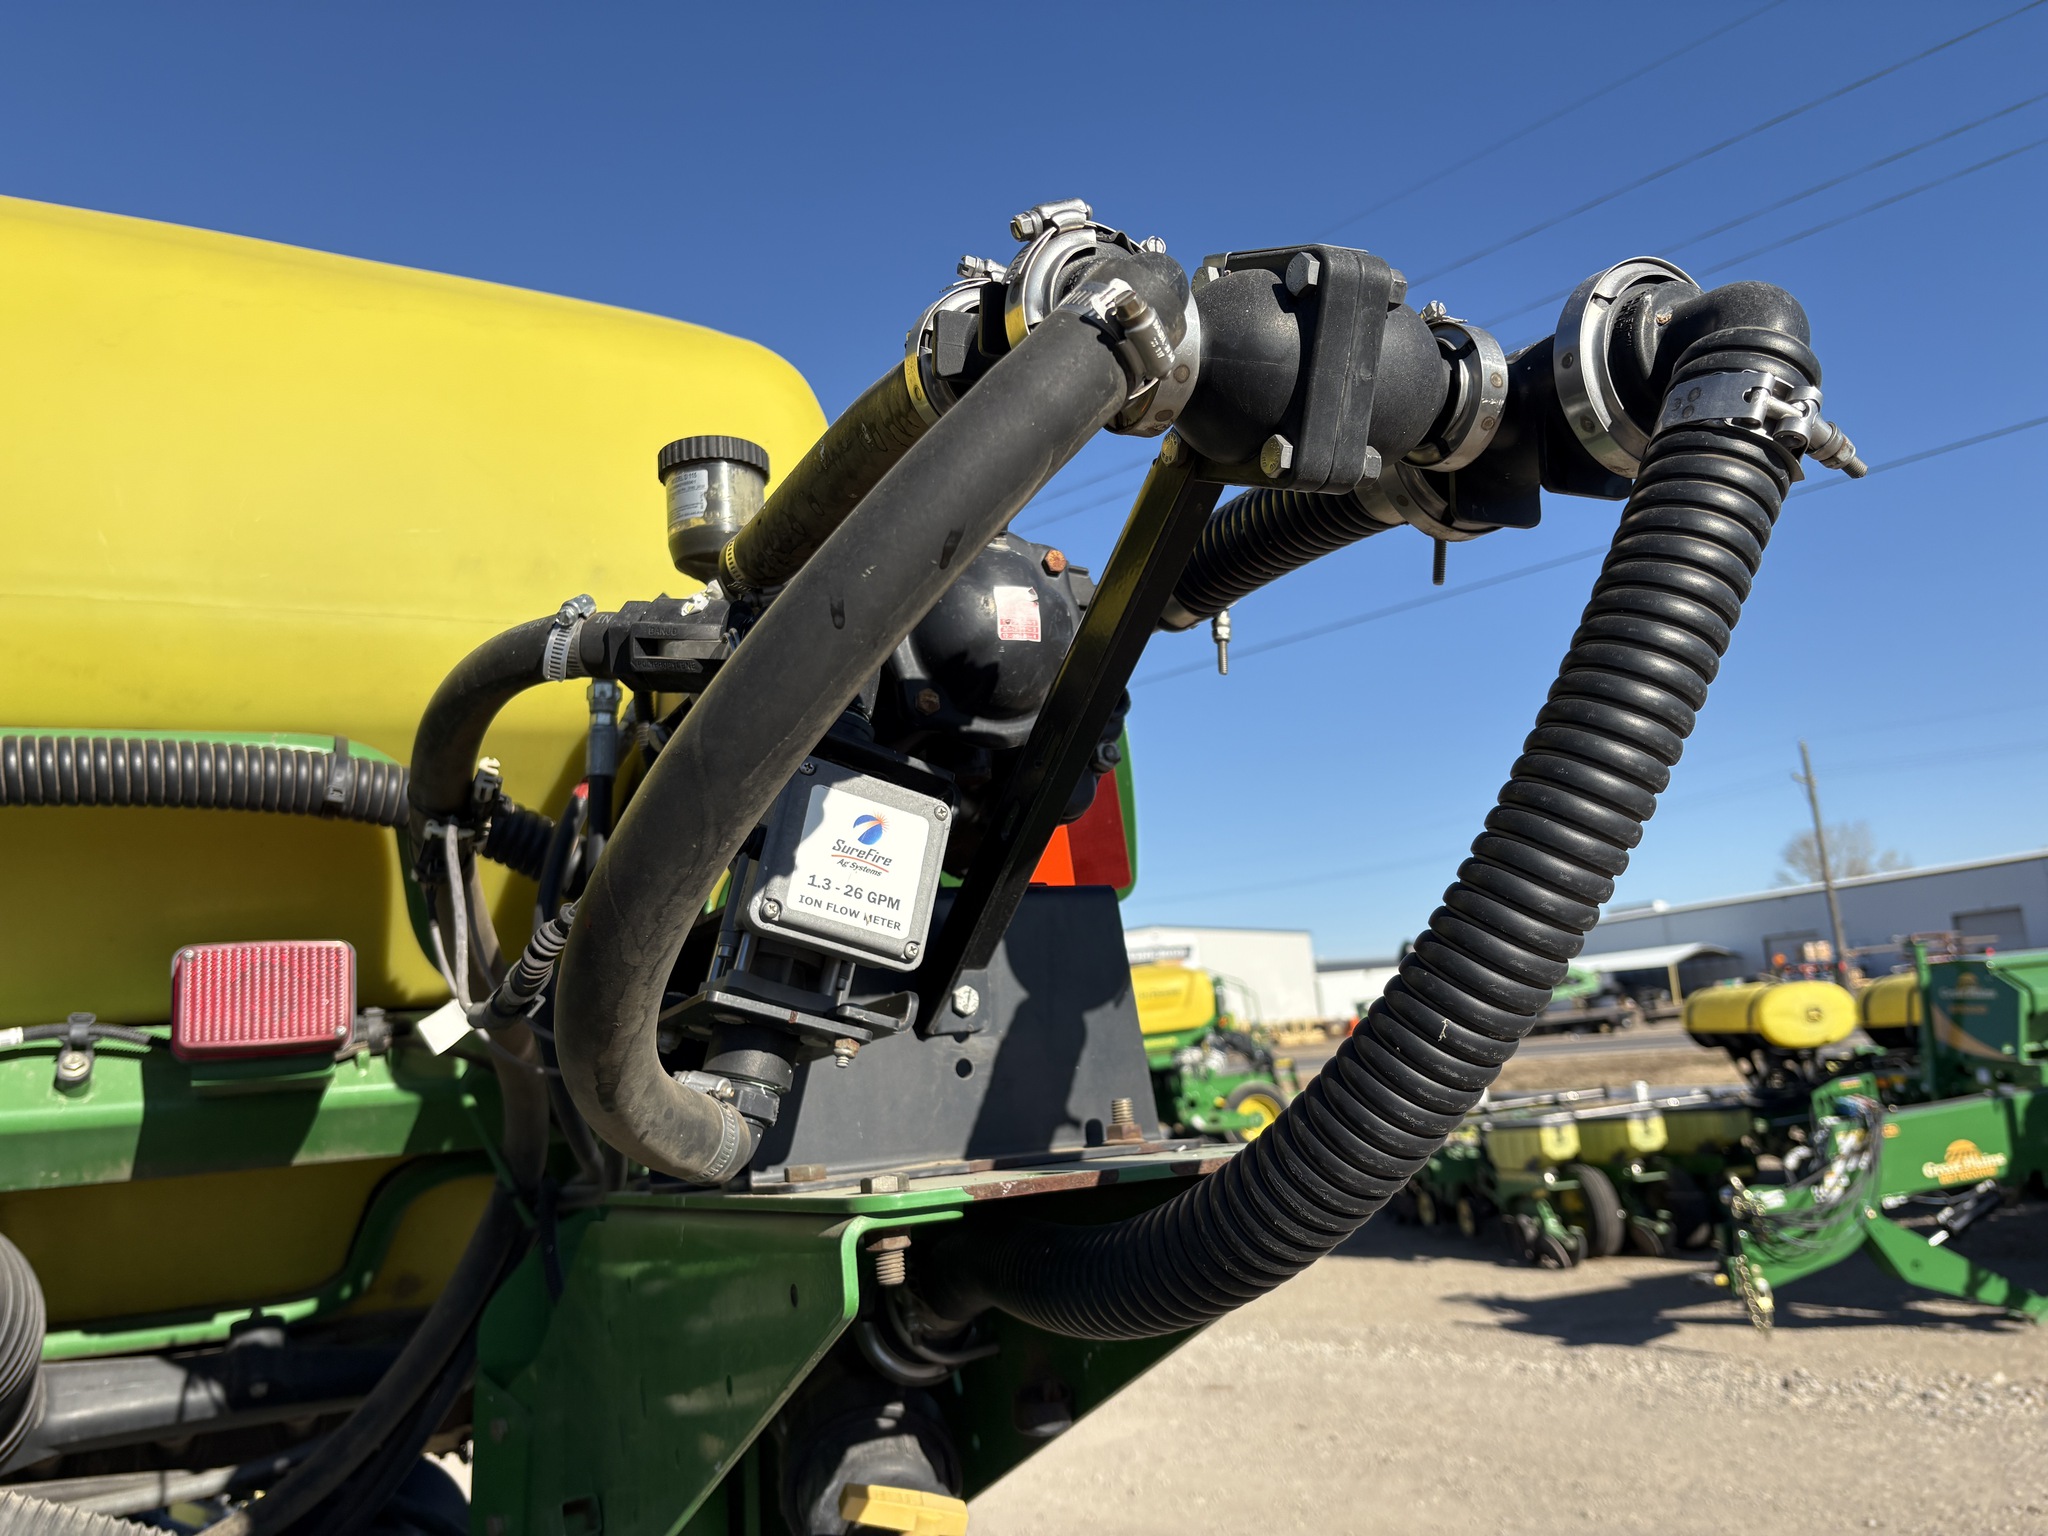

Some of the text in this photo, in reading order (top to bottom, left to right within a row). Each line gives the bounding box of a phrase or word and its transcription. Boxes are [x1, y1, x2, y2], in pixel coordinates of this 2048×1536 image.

[648, 627, 677, 636] BANJO
[832, 838, 893, 867] SureFire
[837, 858, 882, 877] Ag Systems
[807, 874, 832, 891] 1.3
[844, 884, 863, 900] 26
[867, 891, 901, 911] GPM
[798, 894, 901, 931] ION FLOW METER
